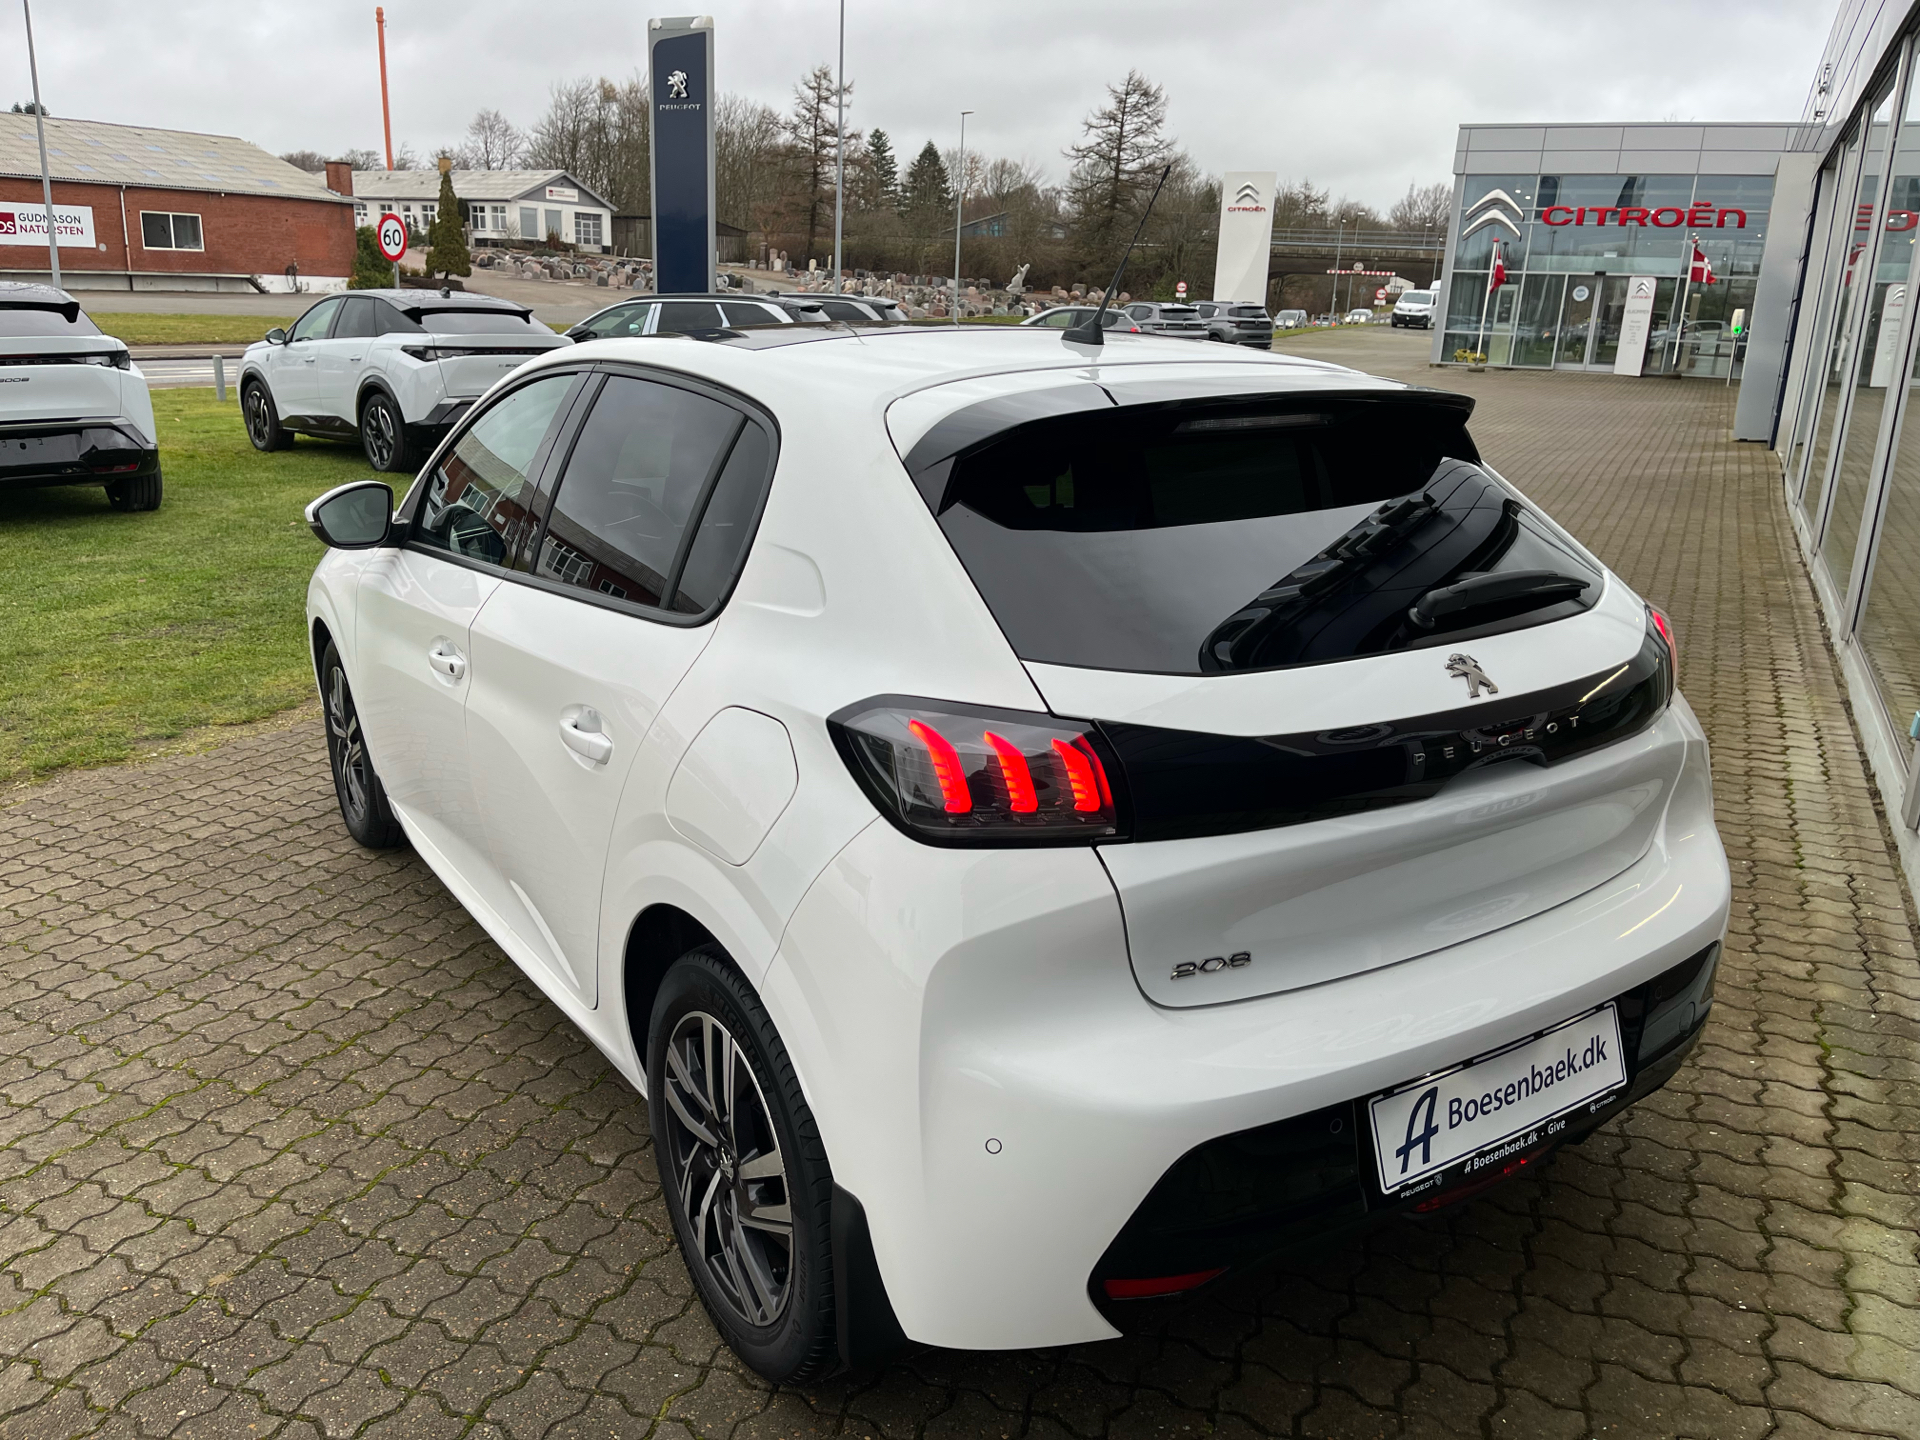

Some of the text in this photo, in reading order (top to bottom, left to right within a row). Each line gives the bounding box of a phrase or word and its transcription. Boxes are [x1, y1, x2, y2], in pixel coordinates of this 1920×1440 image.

[1541, 201, 1747, 229] CITROËN
[19, 224, 84, 236] NATUSTEN
[383, 229, 402, 247] 60
[1412, 715, 1579, 766] PEUGEOT
[1169, 950, 1252, 981] 208
[1448, 1034, 1608, 1130] Boesenbaek.dk
[1473, 1131, 1538, 1170] Boesenbaek.dk
[1547, 1119, 1566, 1135] Give
[1400, 1179, 1434, 1199] PEUGEOT
